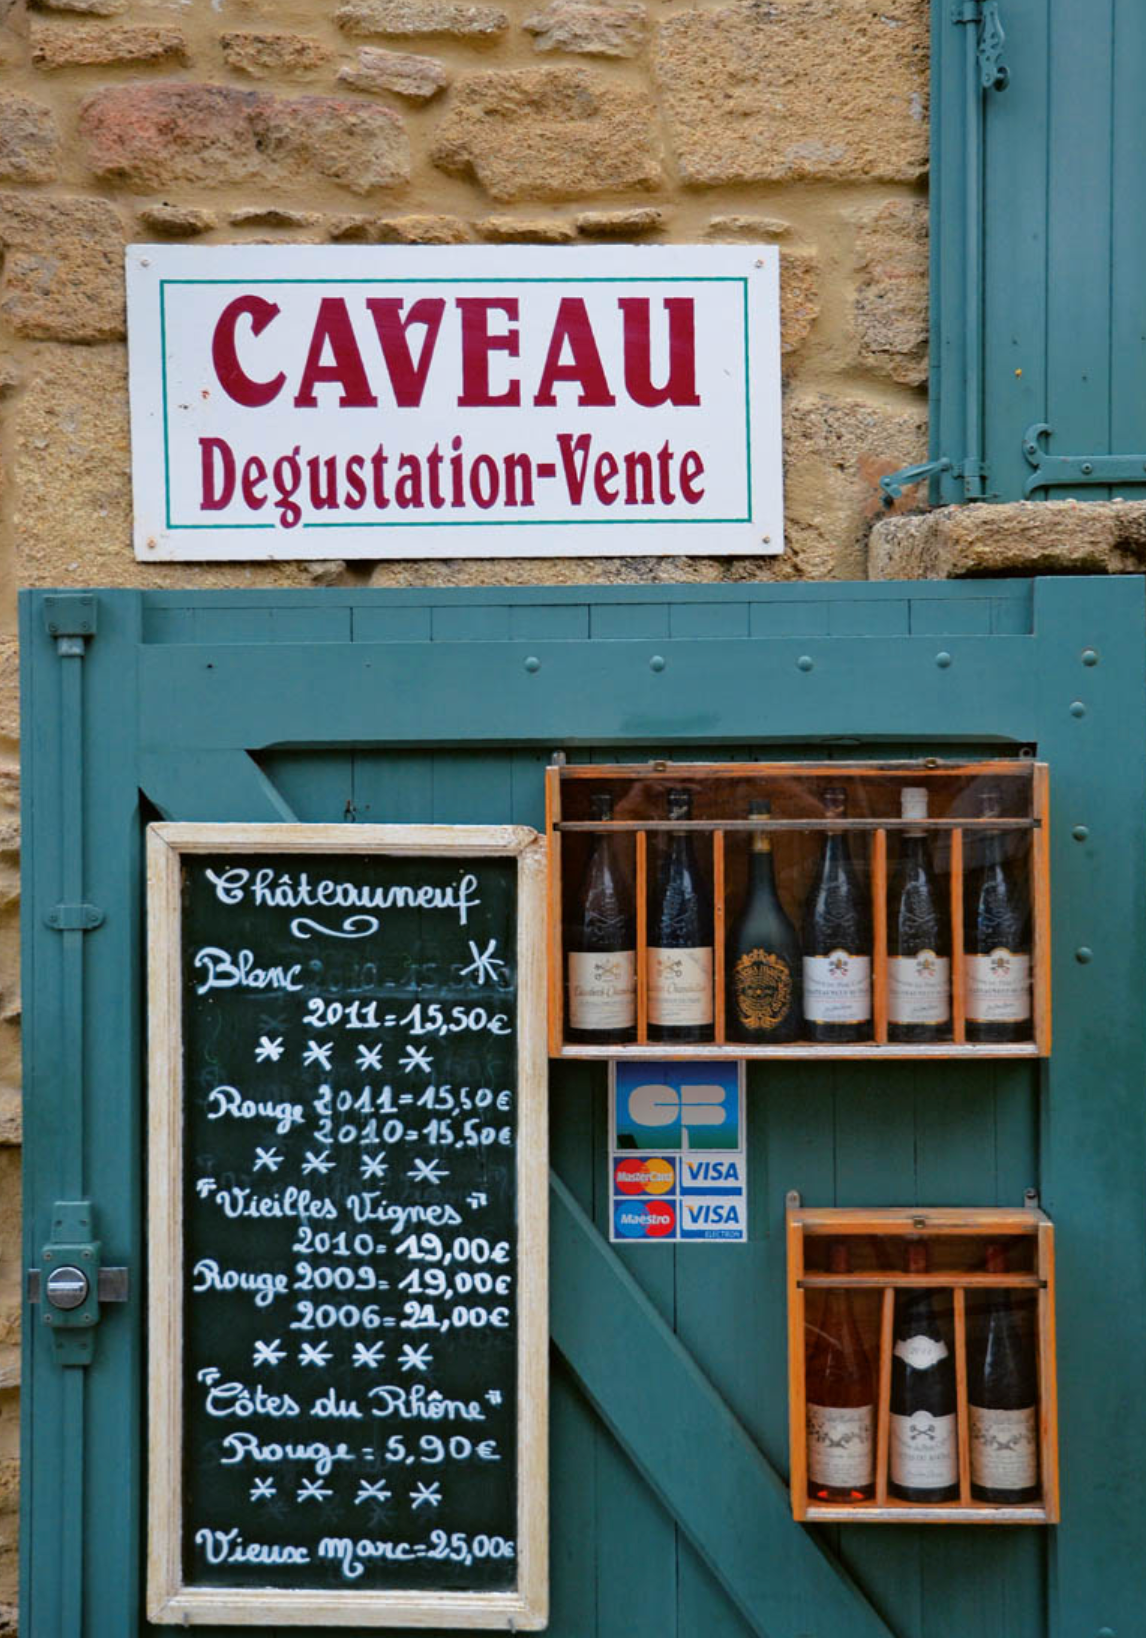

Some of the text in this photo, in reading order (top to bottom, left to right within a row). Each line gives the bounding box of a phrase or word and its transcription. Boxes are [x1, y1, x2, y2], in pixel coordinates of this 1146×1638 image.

[211, 294, 701, 409] CAVEAU
[199, 432, 705, 529] Degustation-Vente
[205, 868, 481, 925] Châteauneuf
[195, 946, 303, 995] Blanc
[207, 1086, 306, 1134] Rouge
[628, 1084, 726, 1127] CB
[616, 1171, 673, 1183] MasterCard
[687, 1161, 739, 1181] VISA
[620, 1213, 670, 1225] Maestro
[686, 1205, 739, 1225] VISA
[193, 1258, 288, 1307] Rouge
[310, 1387, 363, 1418] du
[220, 1432, 355, 1476] Rouge
[195, 1528, 310, 1564] Vieux
